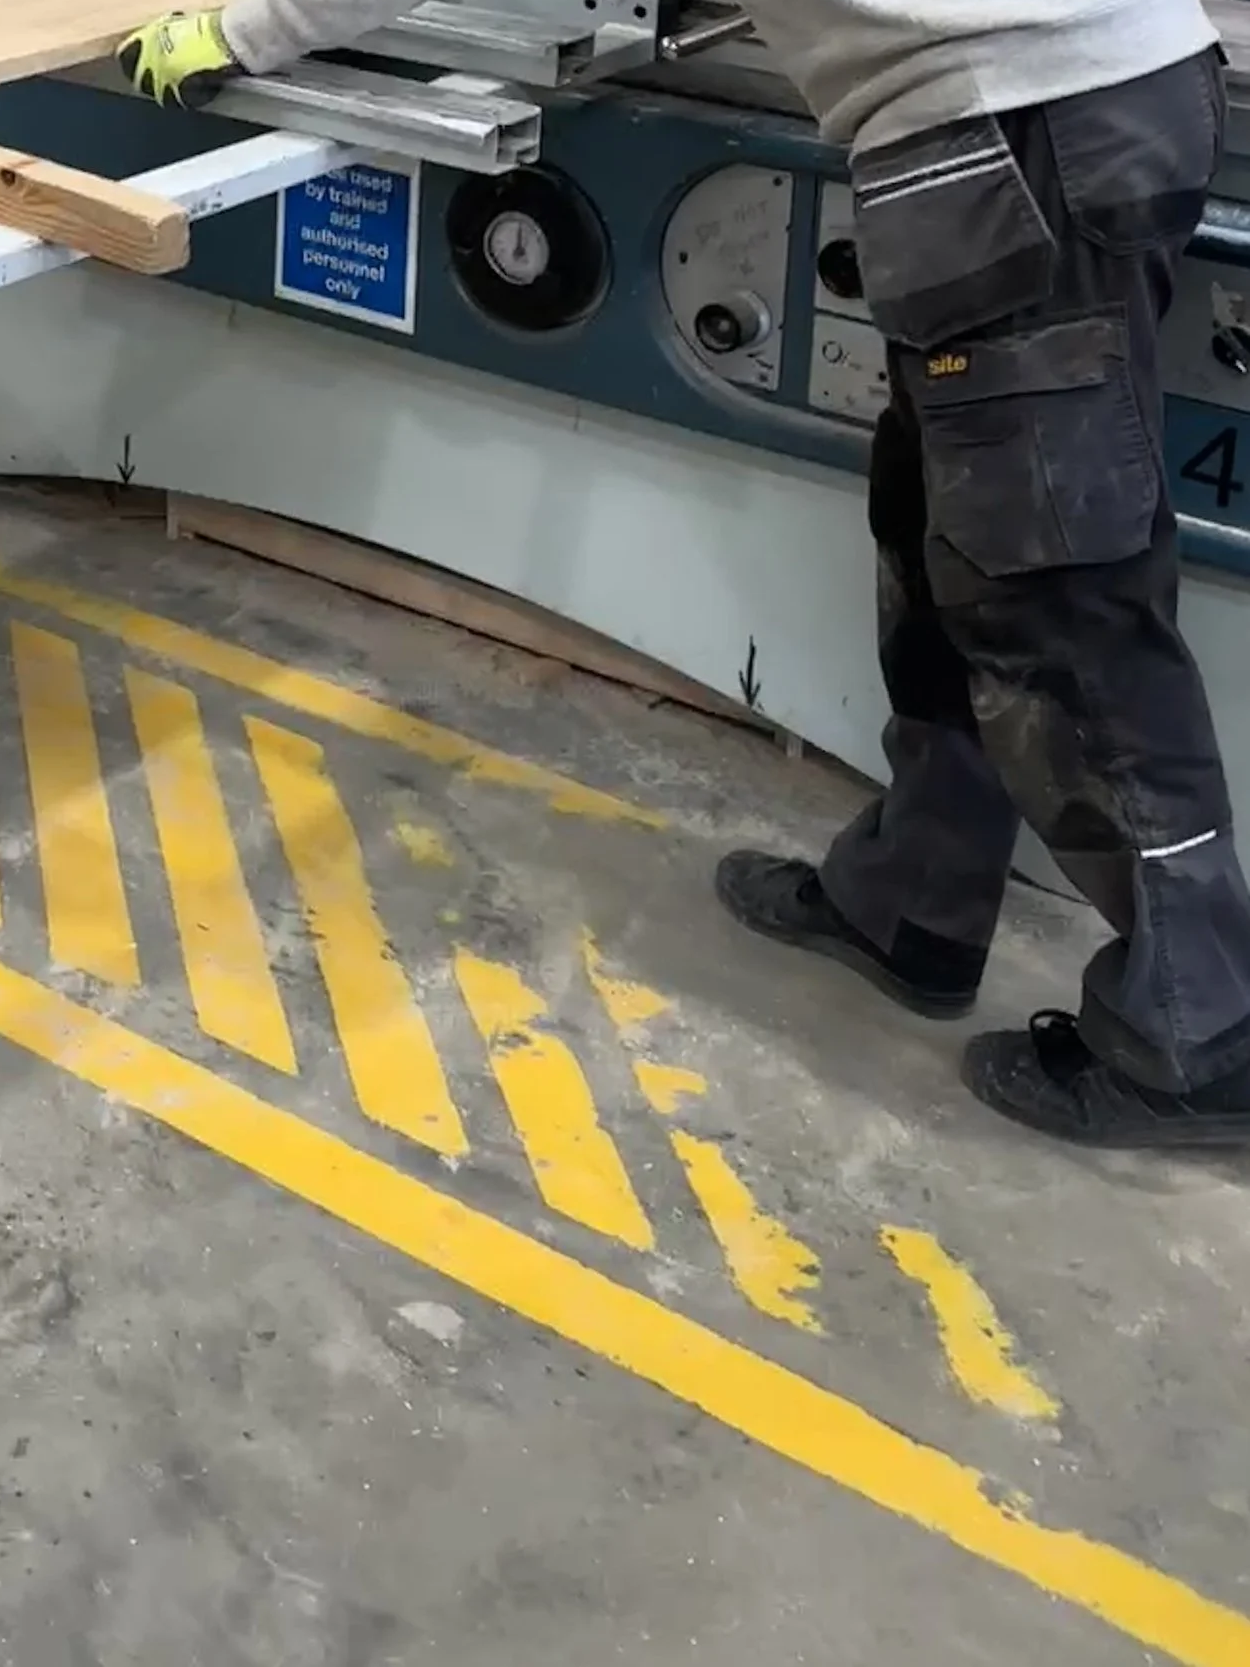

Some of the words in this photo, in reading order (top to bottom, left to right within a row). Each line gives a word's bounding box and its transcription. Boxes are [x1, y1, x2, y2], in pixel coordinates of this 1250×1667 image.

[306, 182, 326, 201] by
[329, 187, 388, 214] trained
[330, 212, 361, 229] and
[301, 225, 389, 260] authorised
[303, 249, 385, 282] personnel
[325, 277, 361, 299] only
[1180, 427, 1244, 508] 4
